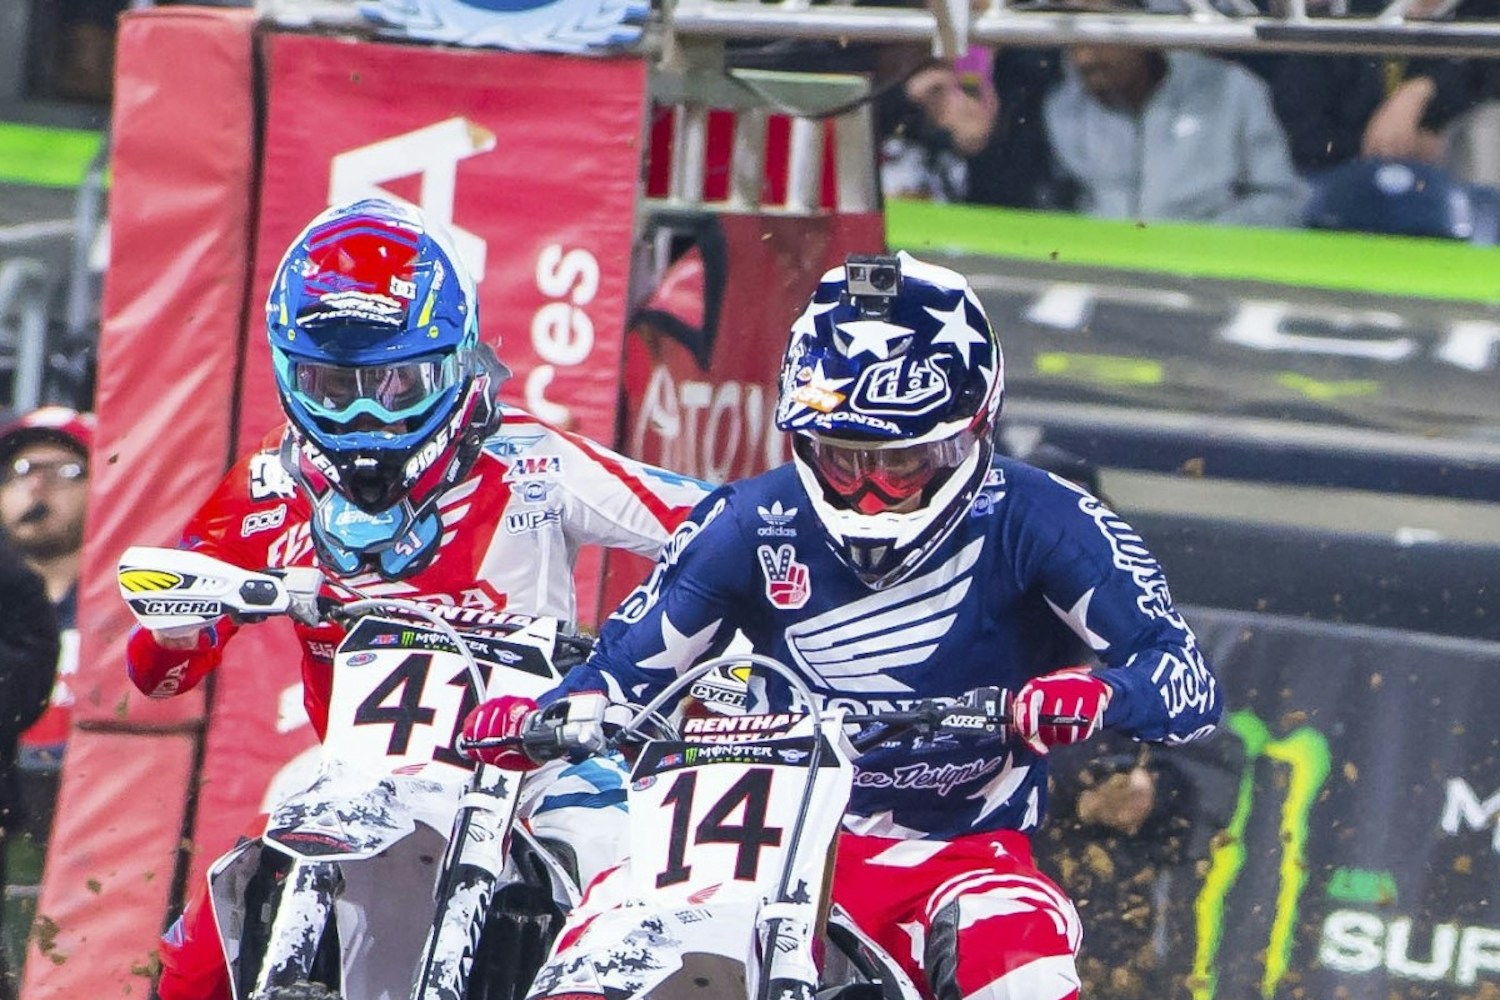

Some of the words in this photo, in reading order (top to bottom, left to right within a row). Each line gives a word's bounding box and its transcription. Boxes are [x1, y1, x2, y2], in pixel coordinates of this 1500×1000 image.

[815, 411, 902, 435] HONDA
[510, 457, 561, 474] AMA
[242, 505, 287, 537] pod
[756, 526, 797, 538] adidas
[146, 601, 221, 616] CYCRA
[352, 651, 494, 773] 41
[698, 745, 773, 759] MONSTER
[655, 767, 784, 889] 14
